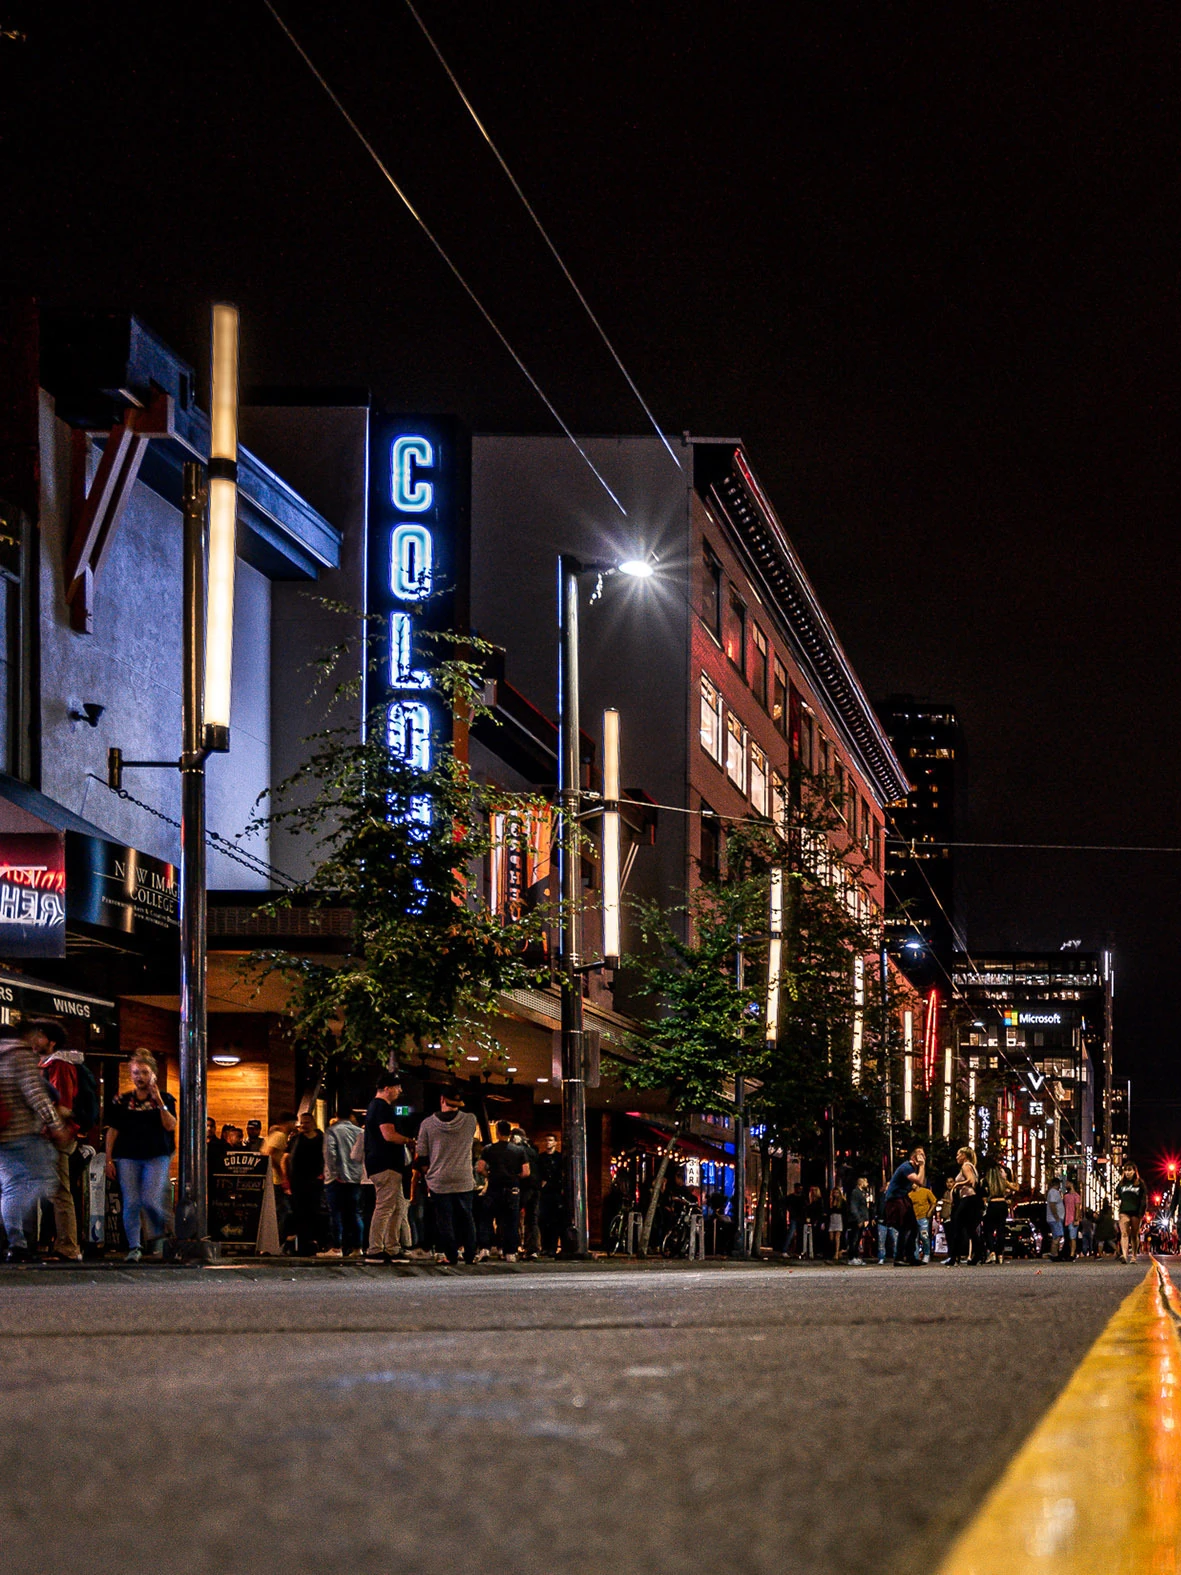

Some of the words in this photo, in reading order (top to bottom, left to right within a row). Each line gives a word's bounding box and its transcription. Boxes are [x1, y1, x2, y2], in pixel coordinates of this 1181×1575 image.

[115, 860, 148, 884] NW
[151, 872, 179, 898] IMAG
[130, 886, 174, 914] COLLEGE
[53, 998, 91, 1018] WINGS
[1019, 1013, 1061, 1024] Microsoft
[224, 1156, 261, 1168] COLONY
